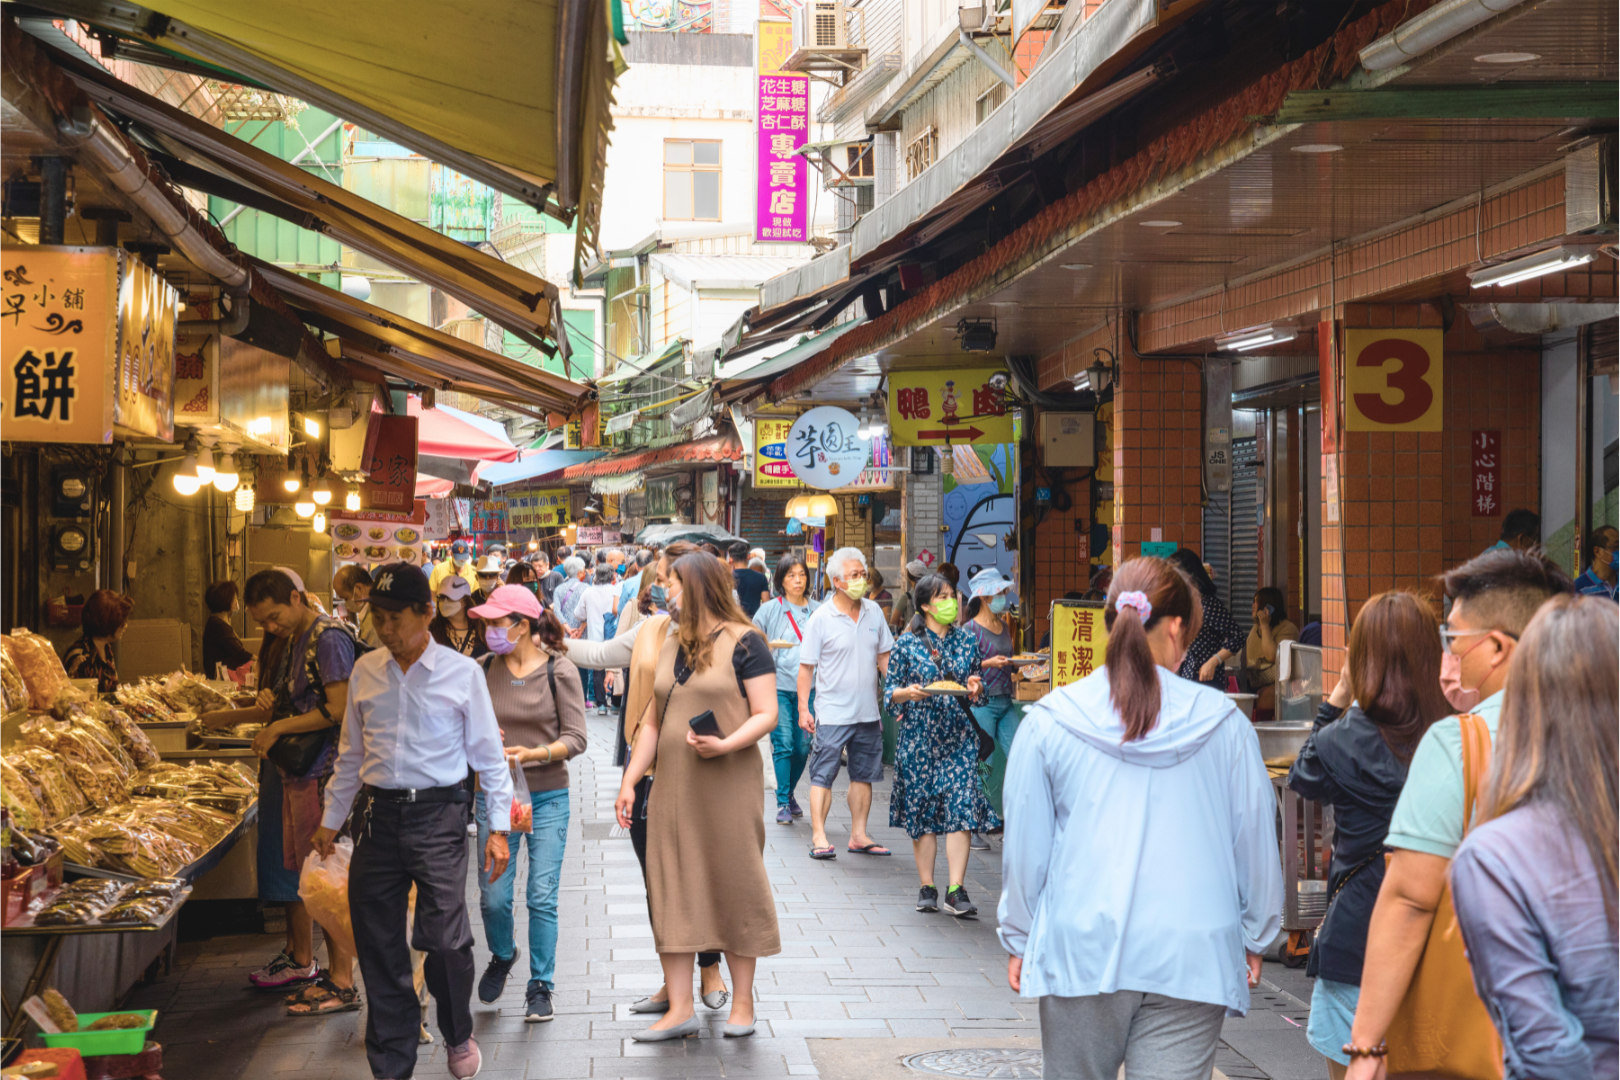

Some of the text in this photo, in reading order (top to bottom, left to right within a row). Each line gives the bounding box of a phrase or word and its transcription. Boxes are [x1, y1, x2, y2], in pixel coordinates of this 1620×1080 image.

[761, 78, 806, 95] 花生糖
[761, 96, 806, 112] 芝麻糖
[761, 114, 806, 131] 杏仁酥
[769, 133, 796, 214] 專賣店
[762, 227, 802, 238] 歡迎試吃
[14, 350, 75, 421] 餅
[896, 387, 931, 420] 鴨
[1353, 338, 1434, 424] 3
[1475, 432, 1497, 515] 小心階梯
[1071, 610, 1094, 677] 清潔
